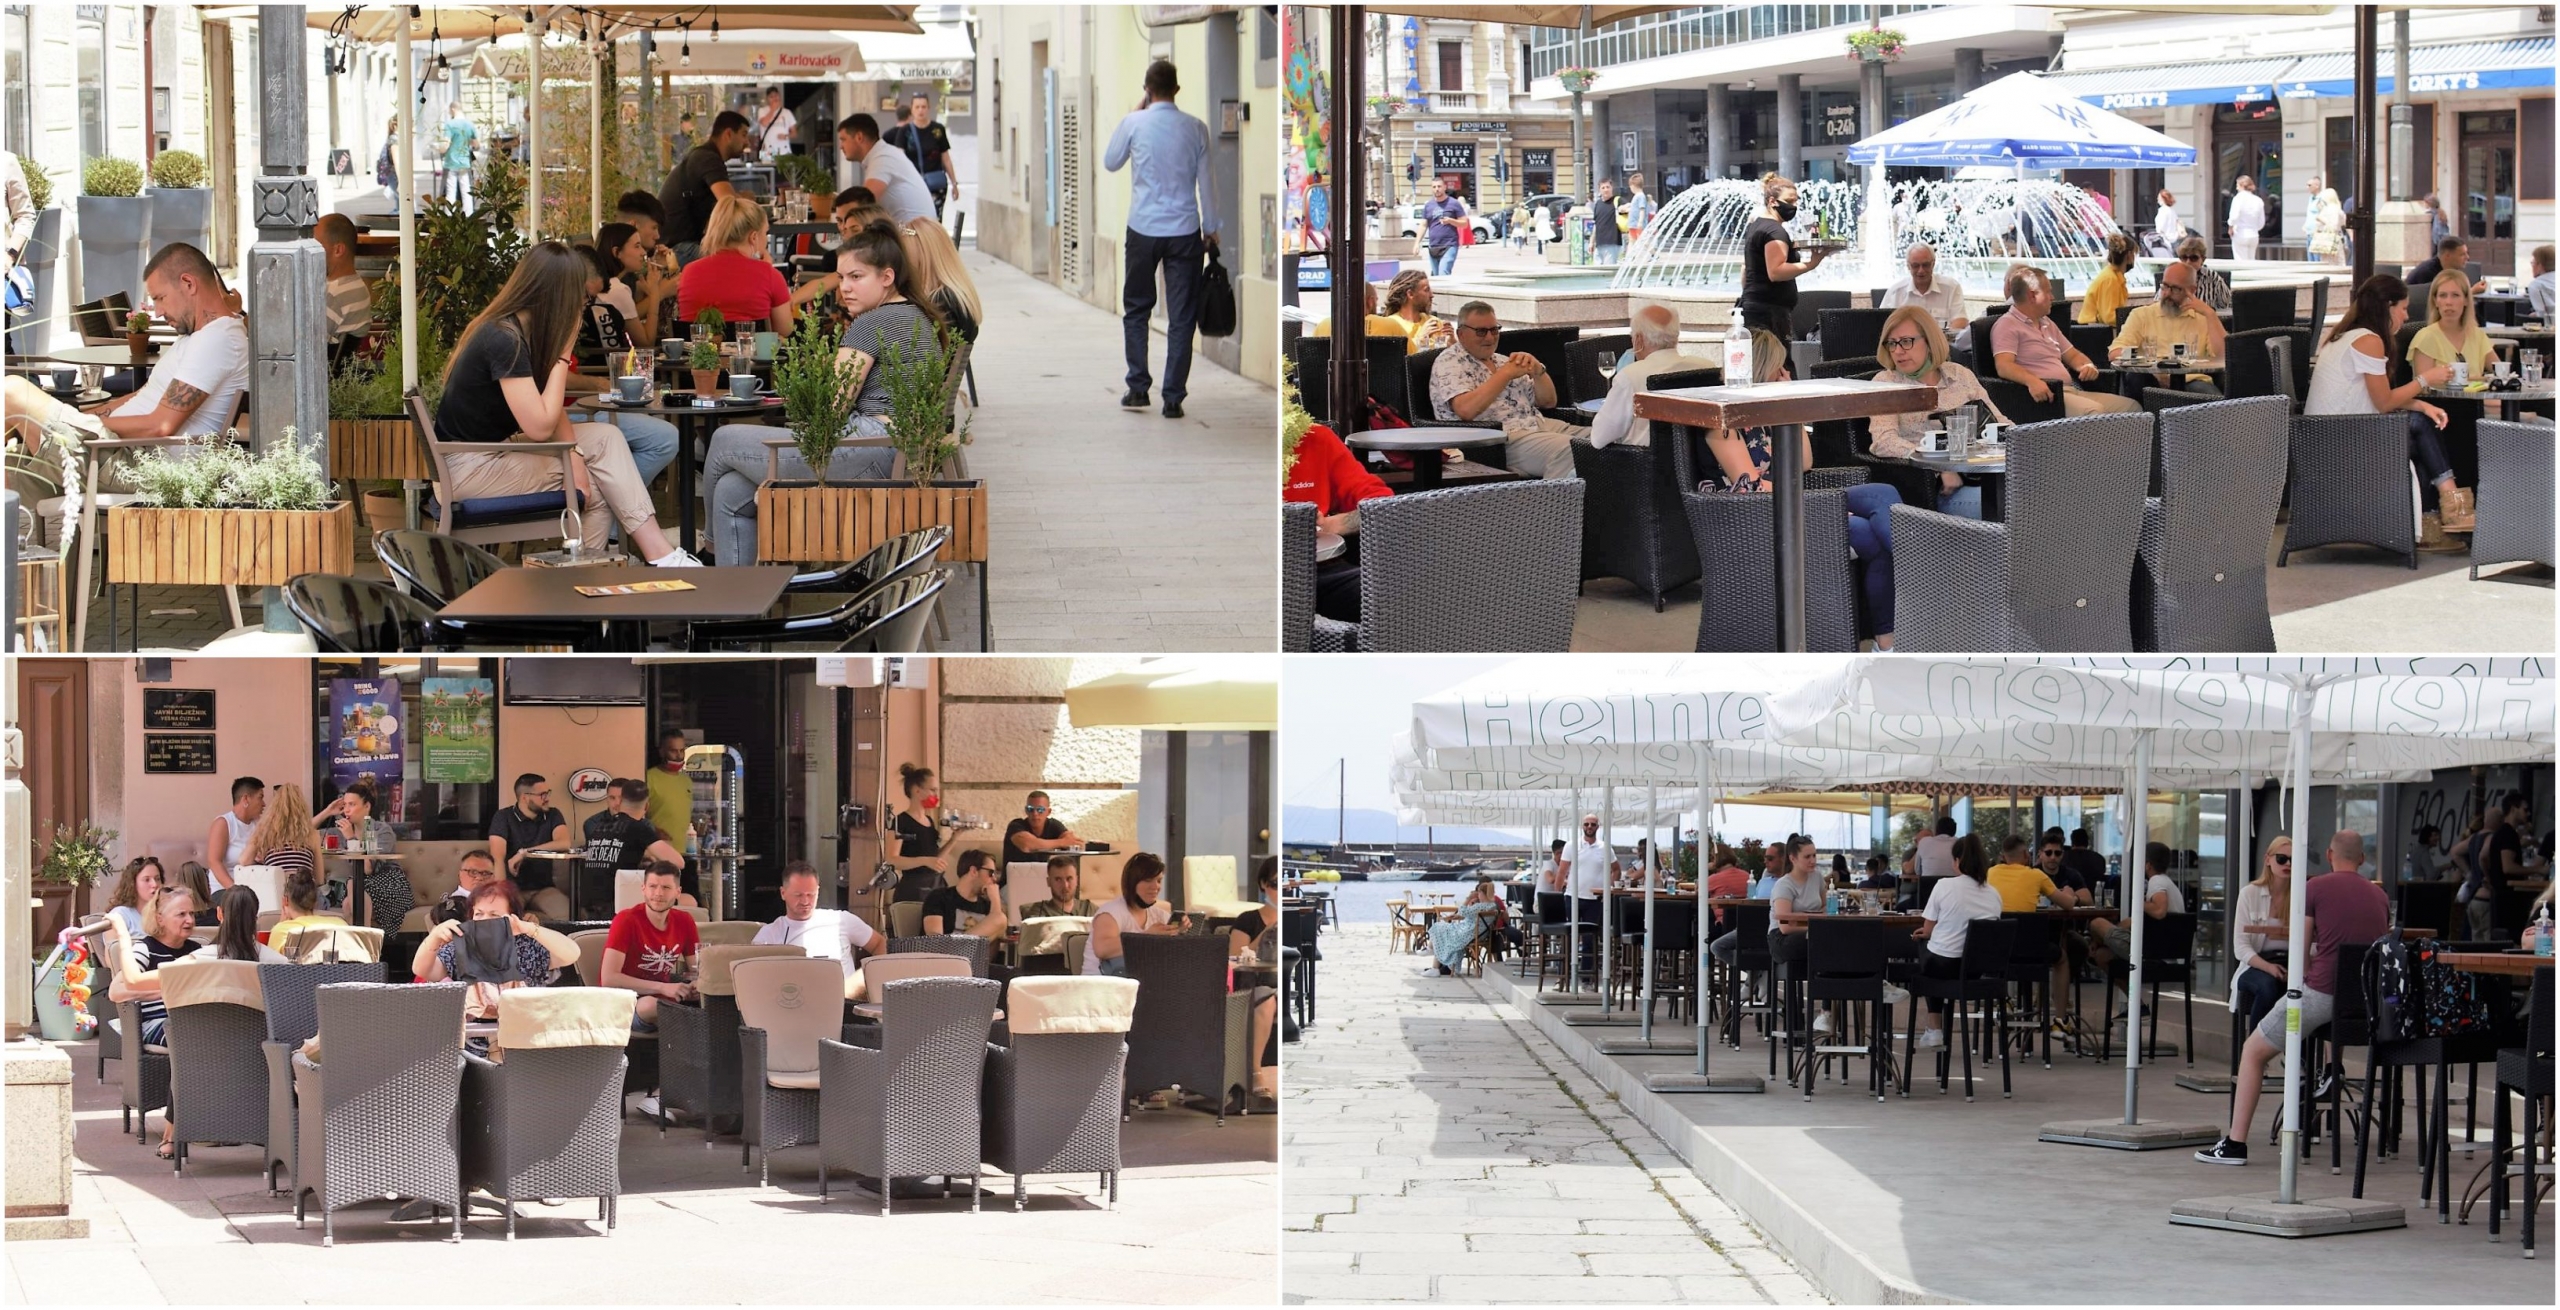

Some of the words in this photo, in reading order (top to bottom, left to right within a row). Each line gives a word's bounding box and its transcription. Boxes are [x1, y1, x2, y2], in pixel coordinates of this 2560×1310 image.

[779, 53, 841, 67] Karlovačko
[2408, 72, 2479, 92] ORKY'S
[2103, 92, 2168, 109] PORKY'S
[1827, 119, 1855, 136] 0-24h
[1293, 481, 1314, 489] adidas
[334, 754, 372, 764] Orangina
[380, 752, 399, 761] kava
[600, 846, 621, 863] DEAN
